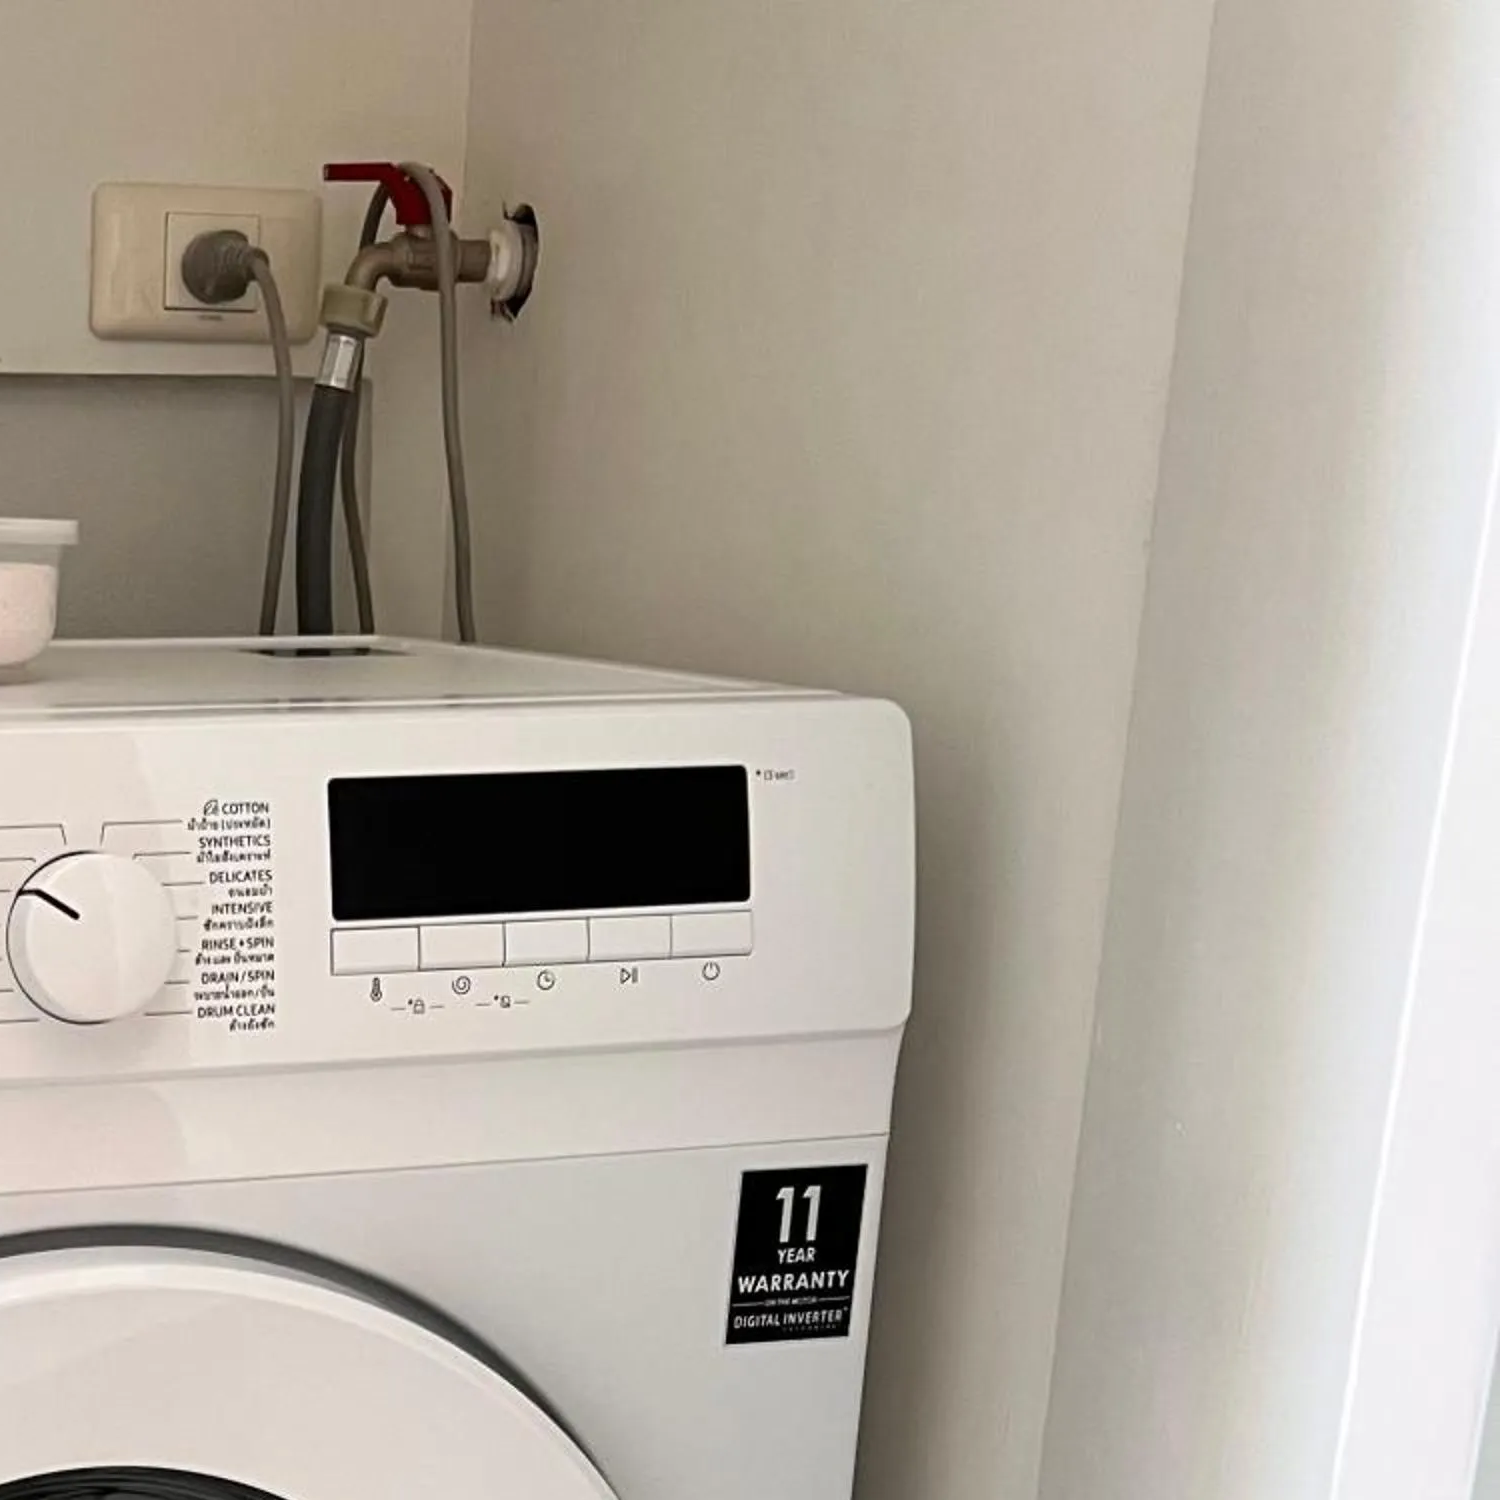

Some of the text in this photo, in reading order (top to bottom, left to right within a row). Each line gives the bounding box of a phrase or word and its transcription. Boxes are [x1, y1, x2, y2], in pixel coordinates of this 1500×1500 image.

[222, 802, 269, 815] COTTON
[198, 834, 271, 849] SYNTHETICS
[209, 869, 273, 884] DELICATES
[211, 901, 273, 915] INTENSIVE
[201, 938, 236, 951] RINSE
[246, 936, 274, 949] SPIN
[197, 1003, 275, 1018] DRUM CLEAN
[775, 1184, 822, 1243] 11
[777, 1247, 817, 1264] YEAR
[737, 1269, 850, 1294] WARRANTY
[733, 1313, 780, 1329] DIGITAL
[782, 1309, 843, 1325] INVERTER
